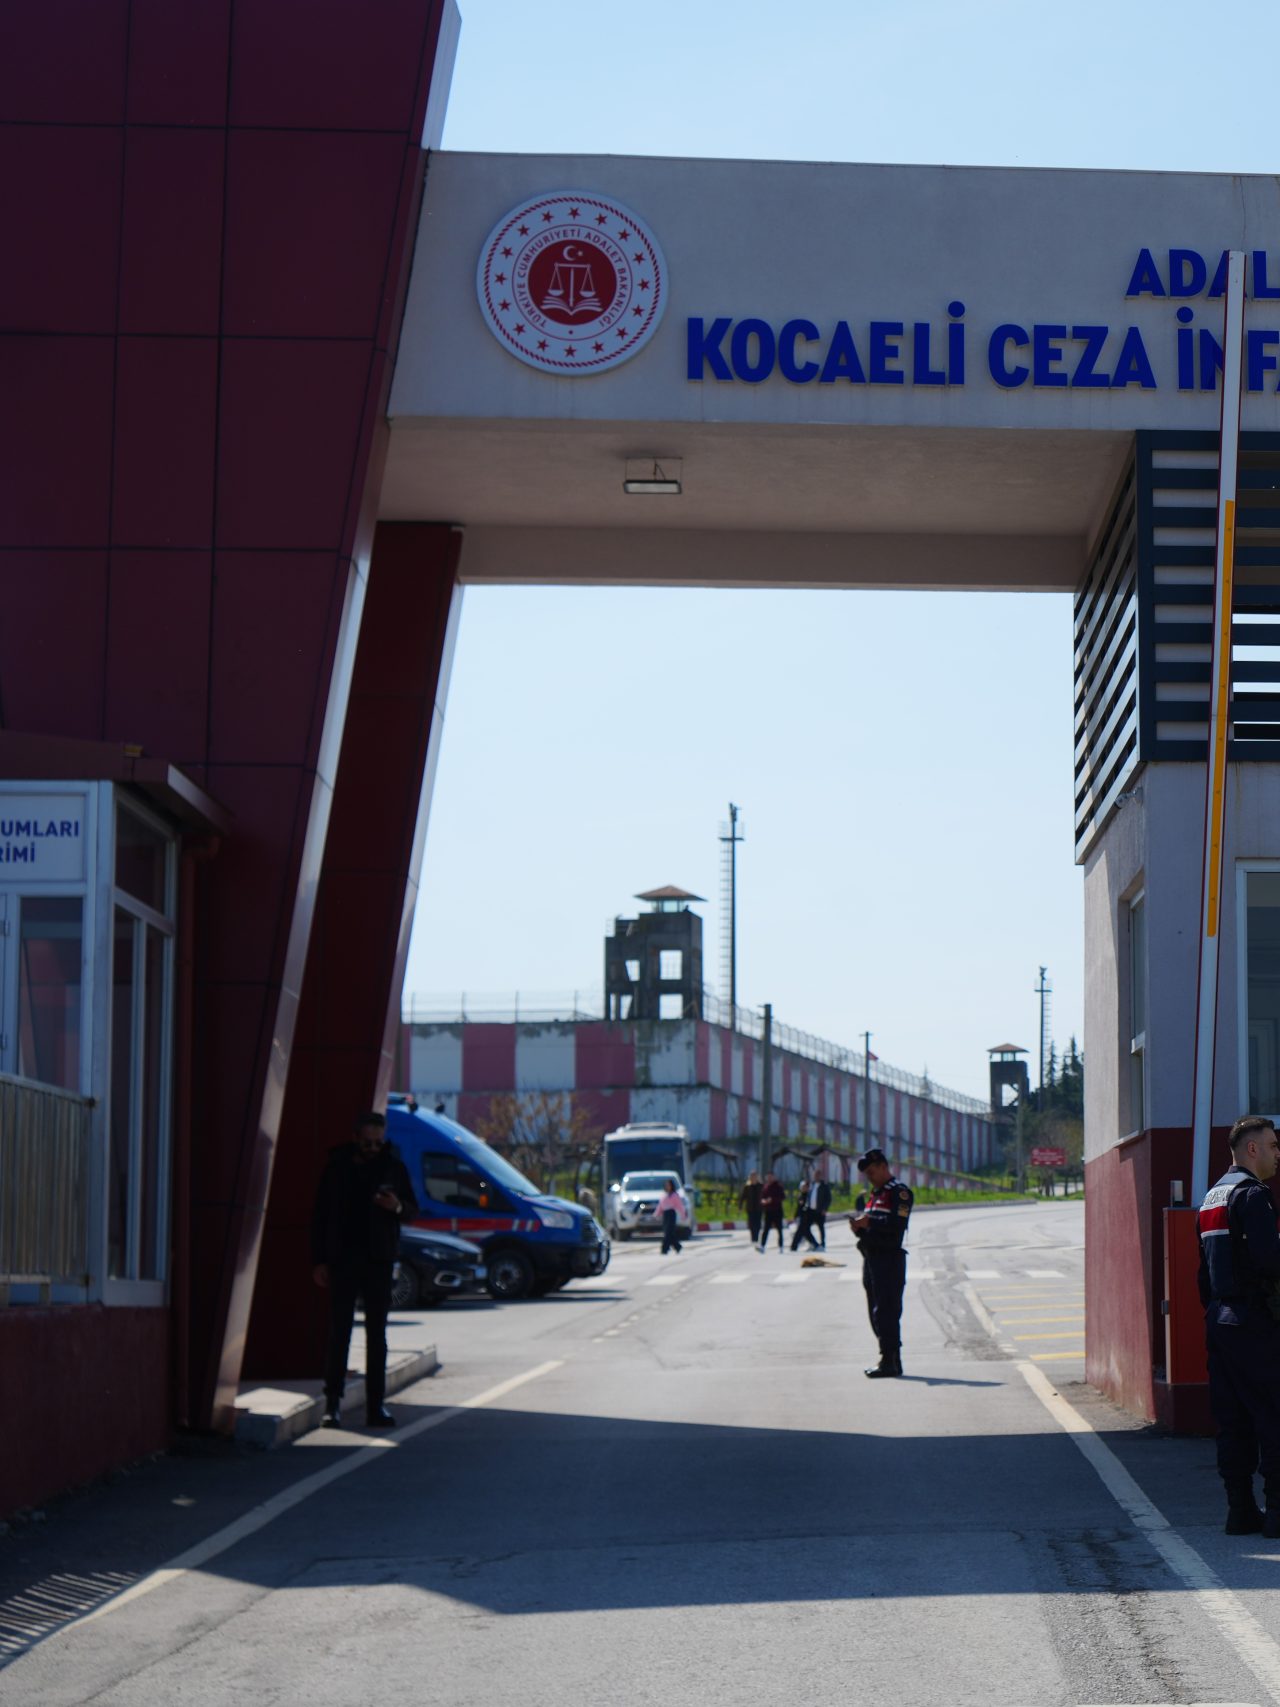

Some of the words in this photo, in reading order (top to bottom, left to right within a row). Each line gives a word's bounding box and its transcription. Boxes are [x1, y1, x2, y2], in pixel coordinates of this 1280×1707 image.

[584, 231, 623, 266] ADALET
[687, 300, 966, 387] KOCAELİ
[987, 322, 1158, 389] CEZA
